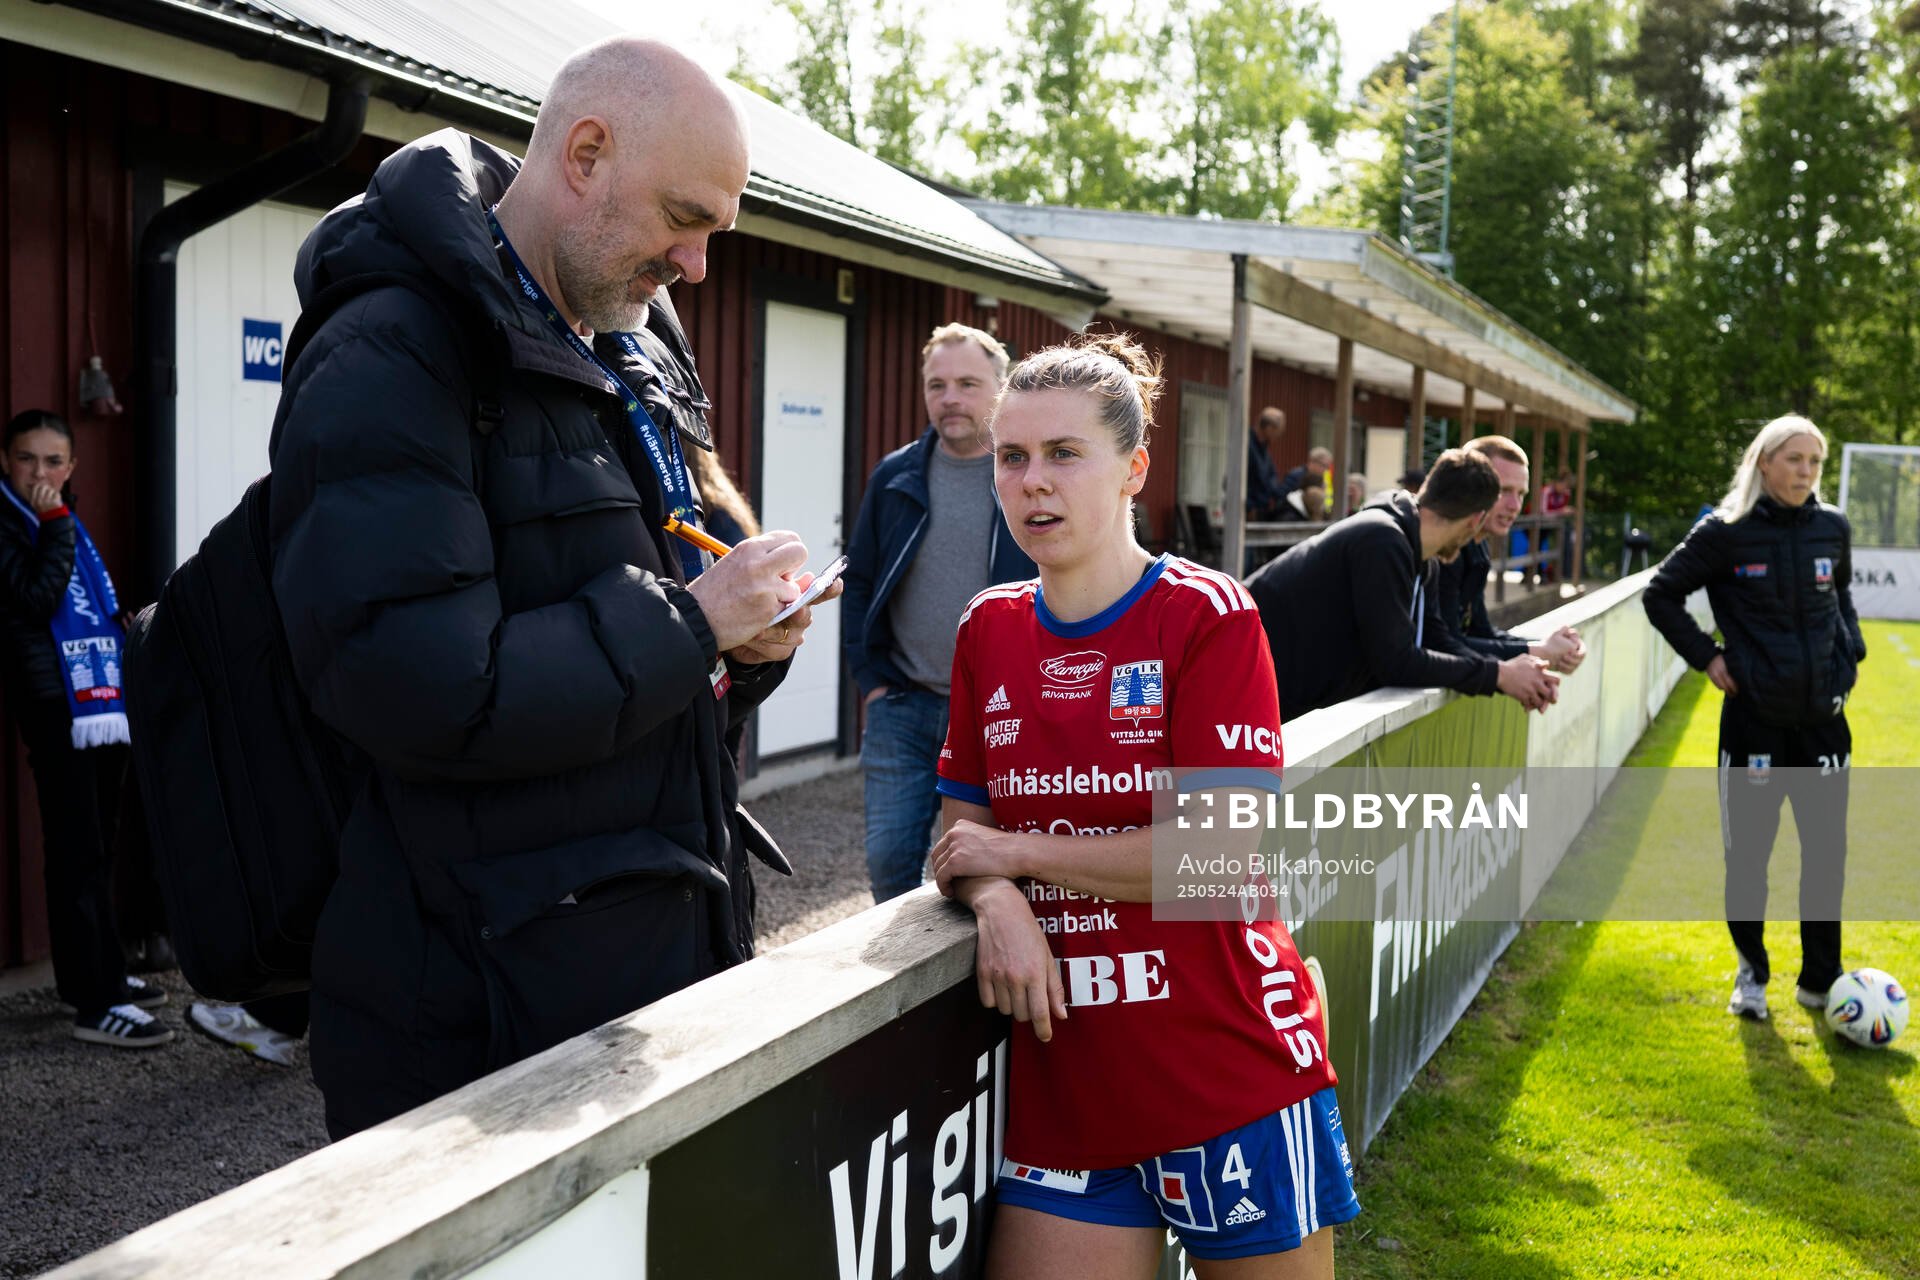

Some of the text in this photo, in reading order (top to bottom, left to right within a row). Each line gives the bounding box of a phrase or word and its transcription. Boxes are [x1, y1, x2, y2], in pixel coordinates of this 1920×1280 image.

[244, 335, 281, 367] WC
[640, 424, 675, 493] #viärsverige
[1045, 658, 1105, 680] Carnegie
[1041, 689, 1093, 700] PRIVATBANK
[985, 701, 1011, 713] adidas
[989, 718, 1020, 736] INTER
[1110, 728, 1164, 739] VITTSJÖ GIK
[989, 731, 1020, 749] SPORT
[1221, 1142, 1252, 1190] 4
[828, 1108, 908, 1280] Vi
[1225, 1208, 1267, 1226] adidas
